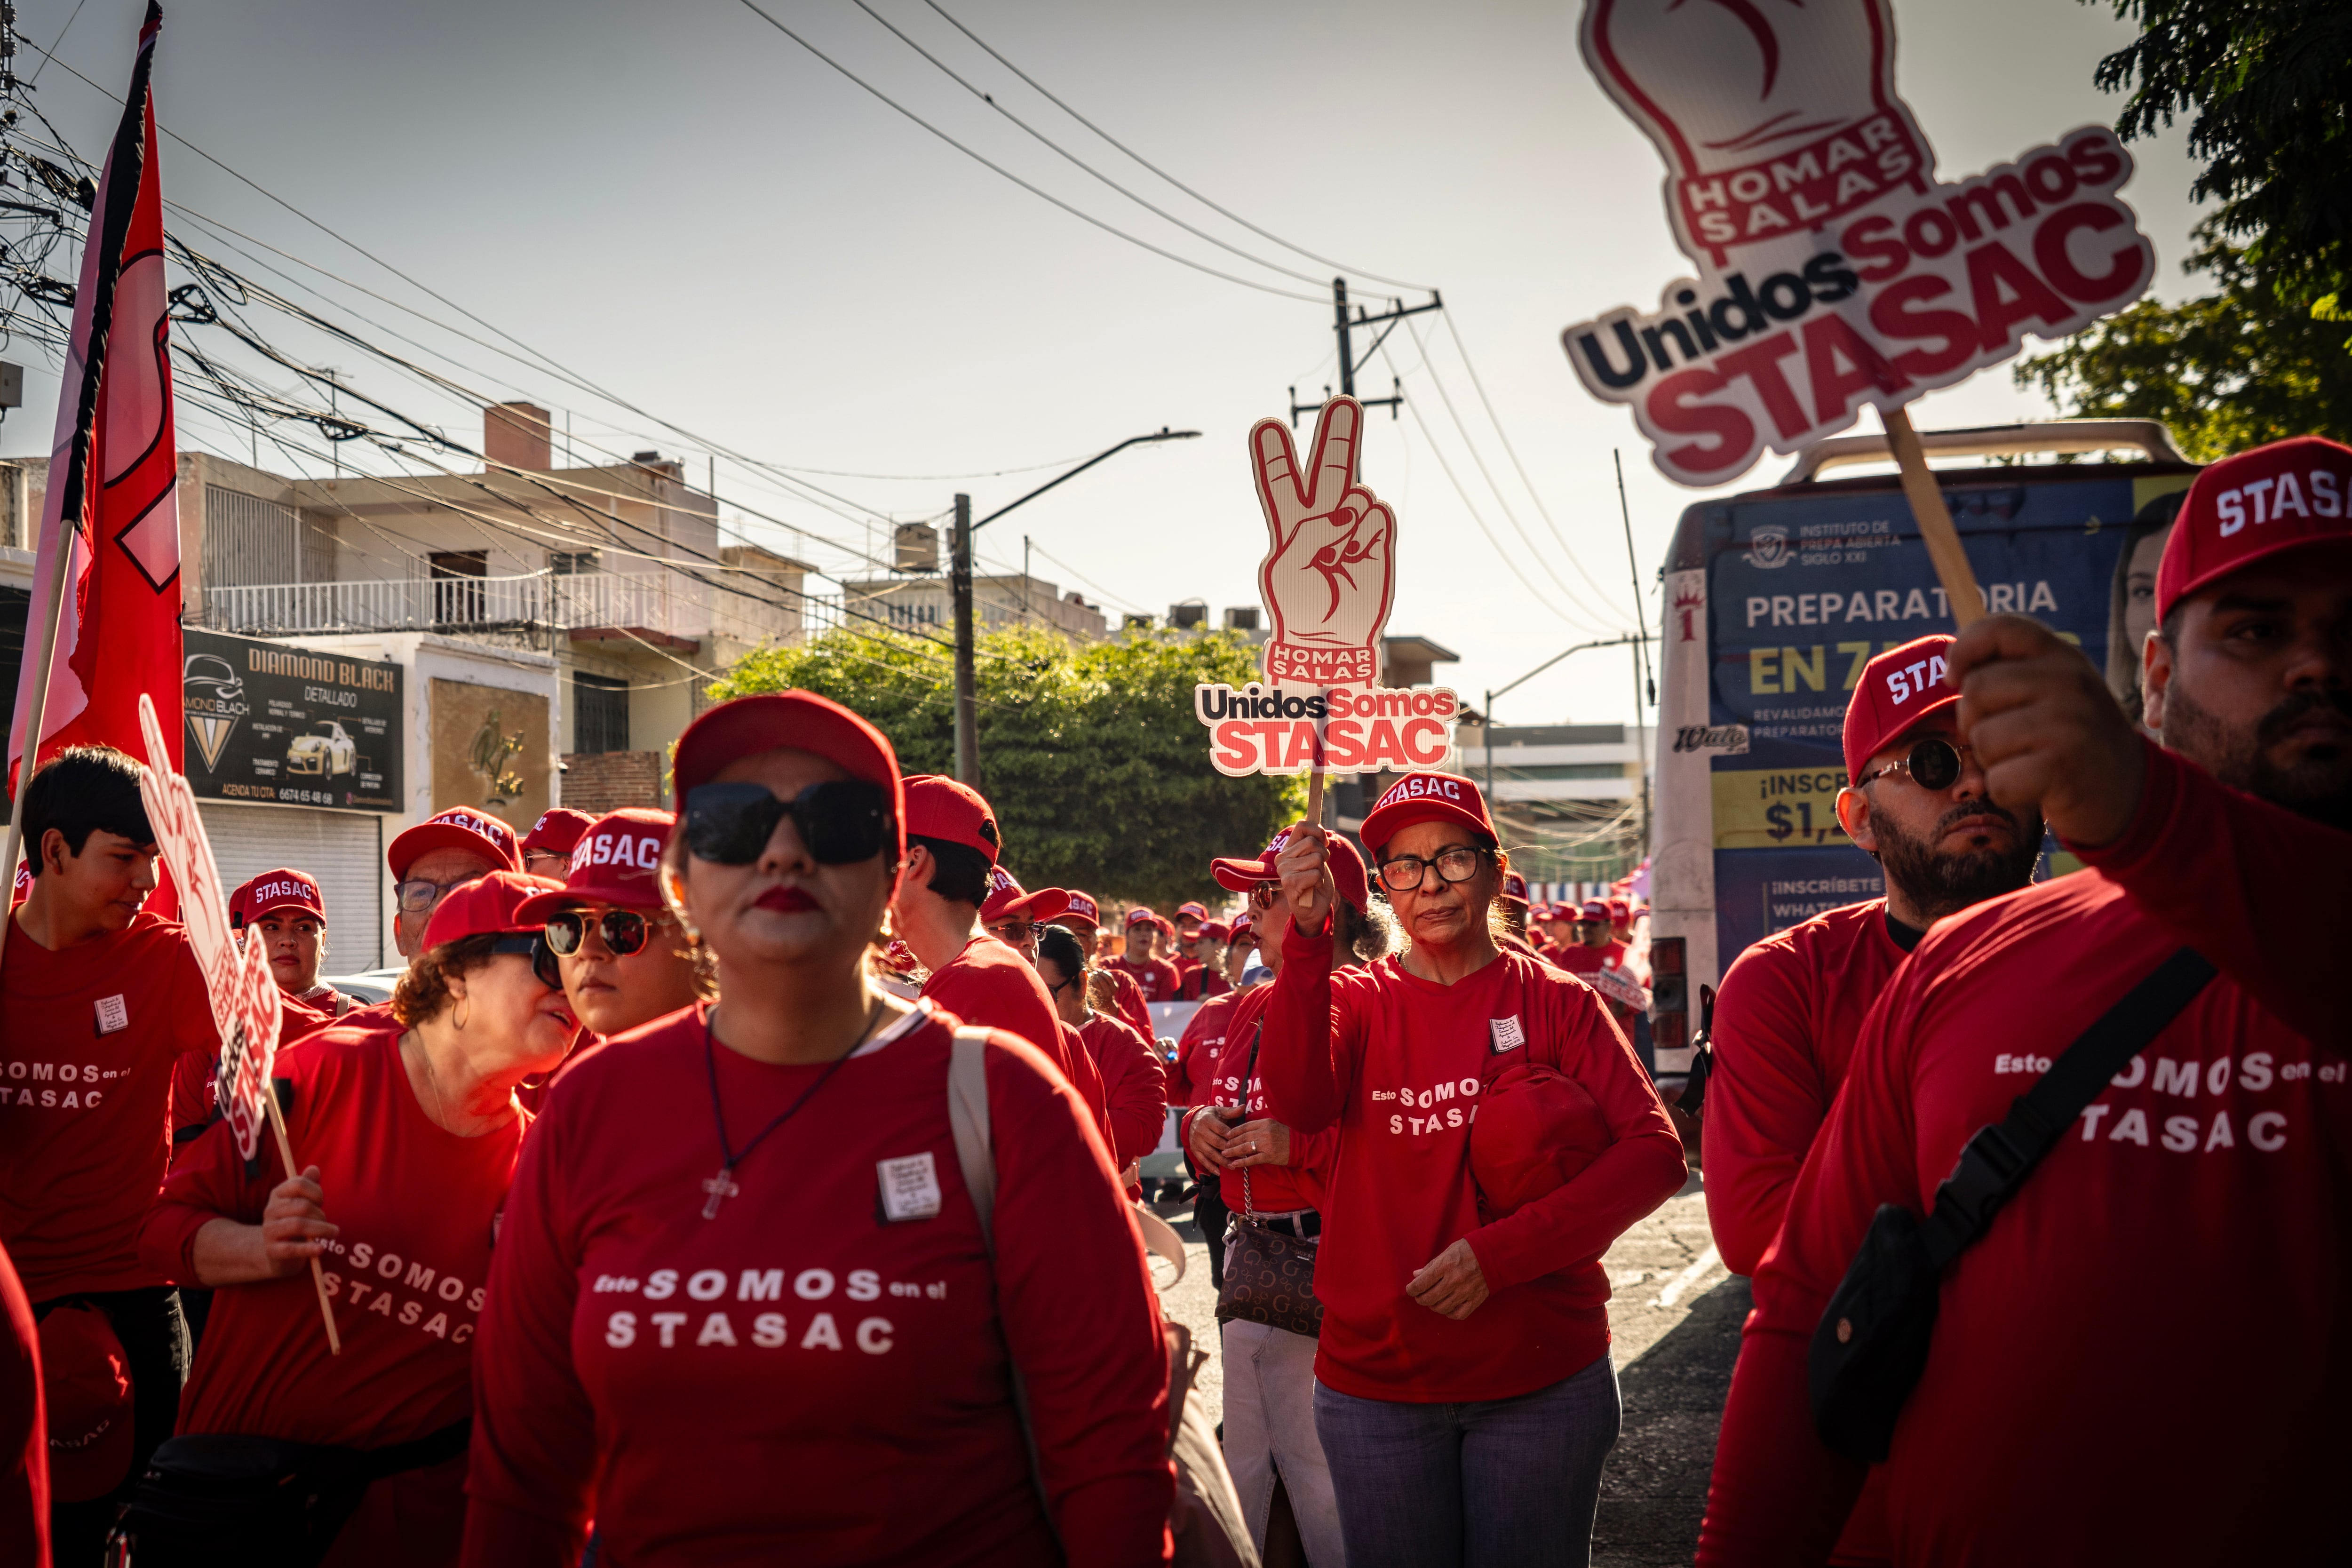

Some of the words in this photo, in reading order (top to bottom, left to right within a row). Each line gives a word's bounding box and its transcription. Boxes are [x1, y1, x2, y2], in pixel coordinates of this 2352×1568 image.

[1692, 117, 1896, 210] HOMAR
[1699, 142, 1914, 245] SALAS
[1578, 253, 1859, 390] Unidos
[1842, 134, 2121, 282] Somos
[1646, 201, 2144, 474] STASAC
[2217, 470, 2352, 538] STAS
[1800, 521, 1870, 537] INSTITUTO
[1872, 520, 1890, 533] DE
[1800, 538, 1842, 551] PREPA
[1845, 535, 1902, 549] ABIERTA
[1801, 552, 1842, 565] SIGLO
[1844, 551, 1867, 563] XXI
[249, 647, 335, 682] DIAMOND
[1273, 661, 1372, 680] SALAS
[1274, 645, 1371, 664] HOMAR
[1750, 645, 1826, 695] EN
[1837, 641, 1871, 691] 7
[304, 685, 358, 708] DETALLADO
[1202, 686, 1327, 720] Unidos
[1325, 688, 1454, 718] Somos
[1216, 718, 1446, 769] STASAC
[222, 783, 250, 797] AGENDA
[251, 785, 259, 797] TU
[279, 788, 299, 800] 6674
[255, 881, 311, 903] STASAC
[0, 1061, 99, 1083] OMOS
[1994, 1053, 2052, 1074] Esto
[2280, 1062, 2311, 1081] en
[2318, 1062, 2346, 1082] el
[1372, 1090, 1396, 1101] Esto
[1400, 1078, 1487, 1109] SOMO
[2080, 1104, 2288, 1153] TASAC
[315, 1238, 346, 1255] sto
[349, 1242, 488, 1313] SOMOS
[593, 1274, 639, 1294] Esto
[643, 1268, 882, 1302] SOMOS
[889, 1281, 920, 1298] en
[926, 1281, 946, 1300] el
[321, 1272, 474, 1344] STASAC
[605, 1311, 894, 1355] STASAC
